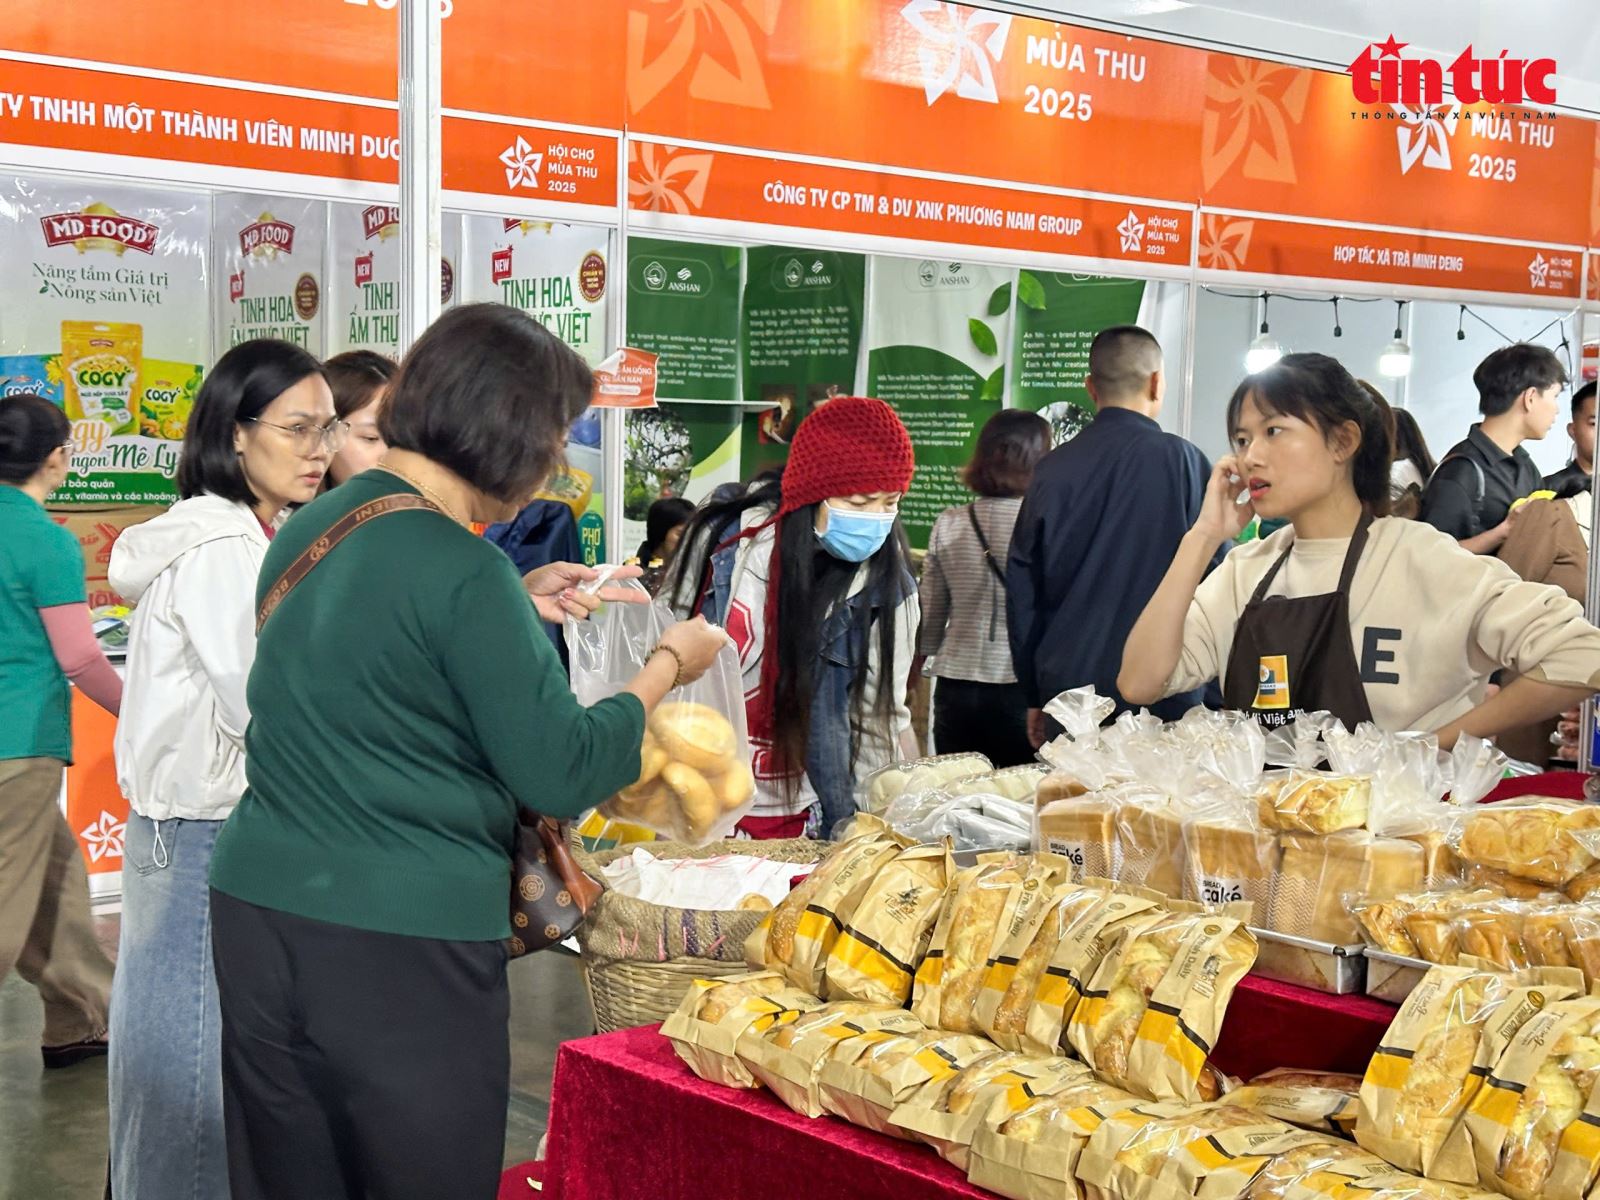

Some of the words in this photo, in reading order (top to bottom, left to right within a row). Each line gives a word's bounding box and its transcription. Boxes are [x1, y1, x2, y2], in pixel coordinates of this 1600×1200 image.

[1026, 32, 1085, 73] MÙA
[1094, 47, 1146, 82] THU
[1024, 85, 1092, 121] 2025
[30, 95, 96, 126] TNHH
[103, 101, 156, 133] MỘT
[161, 109, 238, 143] THÀNH
[244, 118, 294, 149] VIÊN
[300, 127, 355, 155] MINH
[1518, 120, 1555, 148] THU
[548, 143, 568, 160] HỘI
[570, 147, 595, 164] CHỢ
[547, 161, 573, 176] MÙA
[575, 165, 598, 179] THU
[1468, 153, 1517, 183] 2025
[548, 180, 577, 194] 2025
[367, 207, 385, 230] MD
[763, 180, 806, 206] CÔNG
[810, 188, 829, 208] TY
[831, 191, 850, 210] CP
[853, 193, 874, 213] TM
[878, 196, 889, 215] &
[892, 198, 912, 217] DV
[915, 200, 944, 221] XNK
[947, 203, 1003, 227] PHƯƠNG
[1006, 211, 1035, 231] NAM
[1038, 214, 1083, 236] GROUP
[51, 218, 85, 239] MD
[88, 218, 148, 243] FOOD
[261, 225, 289, 244] FOOD
[1164, 232, 1180, 243] THU
[1146, 244, 1166, 255] 2025
[1334, 245, 1356, 264] HỢP
[1357, 246, 1375, 264] TÁC
[1392, 249, 1410, 267] TRÀ
[1412, 252, 1437, 269] MINH
[1438, 255, 1463, 272] DENG
[33, 262, 76, 284] Nâng
[80, 264, 111, 282] tầm
[115, 268, 145, 286] Giá
[149, 271, 170, 290] trị
[494, 258, 510, 273] NEW
[668, 282, 701, 292] ANSHAN
[804, 275, 832, 285] ANSHAN
[939, 276, 970, 286] ANSHAN
[50, 281, 97, 304] Nông
[99, 288, 127, 303] sản
[129, 286, 162, 308] Việt
[363, 281, 393, 311] TINH
[501, 277, 536, 309] TINH
[540, 276, 574, 308] HOA
[239, 297, 266, 324] TINH
[268, 295, 295, 322] HOA
[557, 307, 592, 348] VIỆT
[79, 370, 123, 387] COGY
[1021, 371, 1043, 379] journey
[145, 388, 176, 403] COGY
[71, 456, 108, 475] ngon
[107, 443, 149, 469] Mê
[153, 443, 178, 476] Ly
[75, 492, 109, 500] vitamin
[111, 492, 122, 500] và
[124, 491, 141, 500] các
[144, 490, 177, 502] khoáng
[1361, 626, 1402, 685] E
[1011, 915, 1025, 937] Daily
[1180, 956, 1196, 979] Daily
